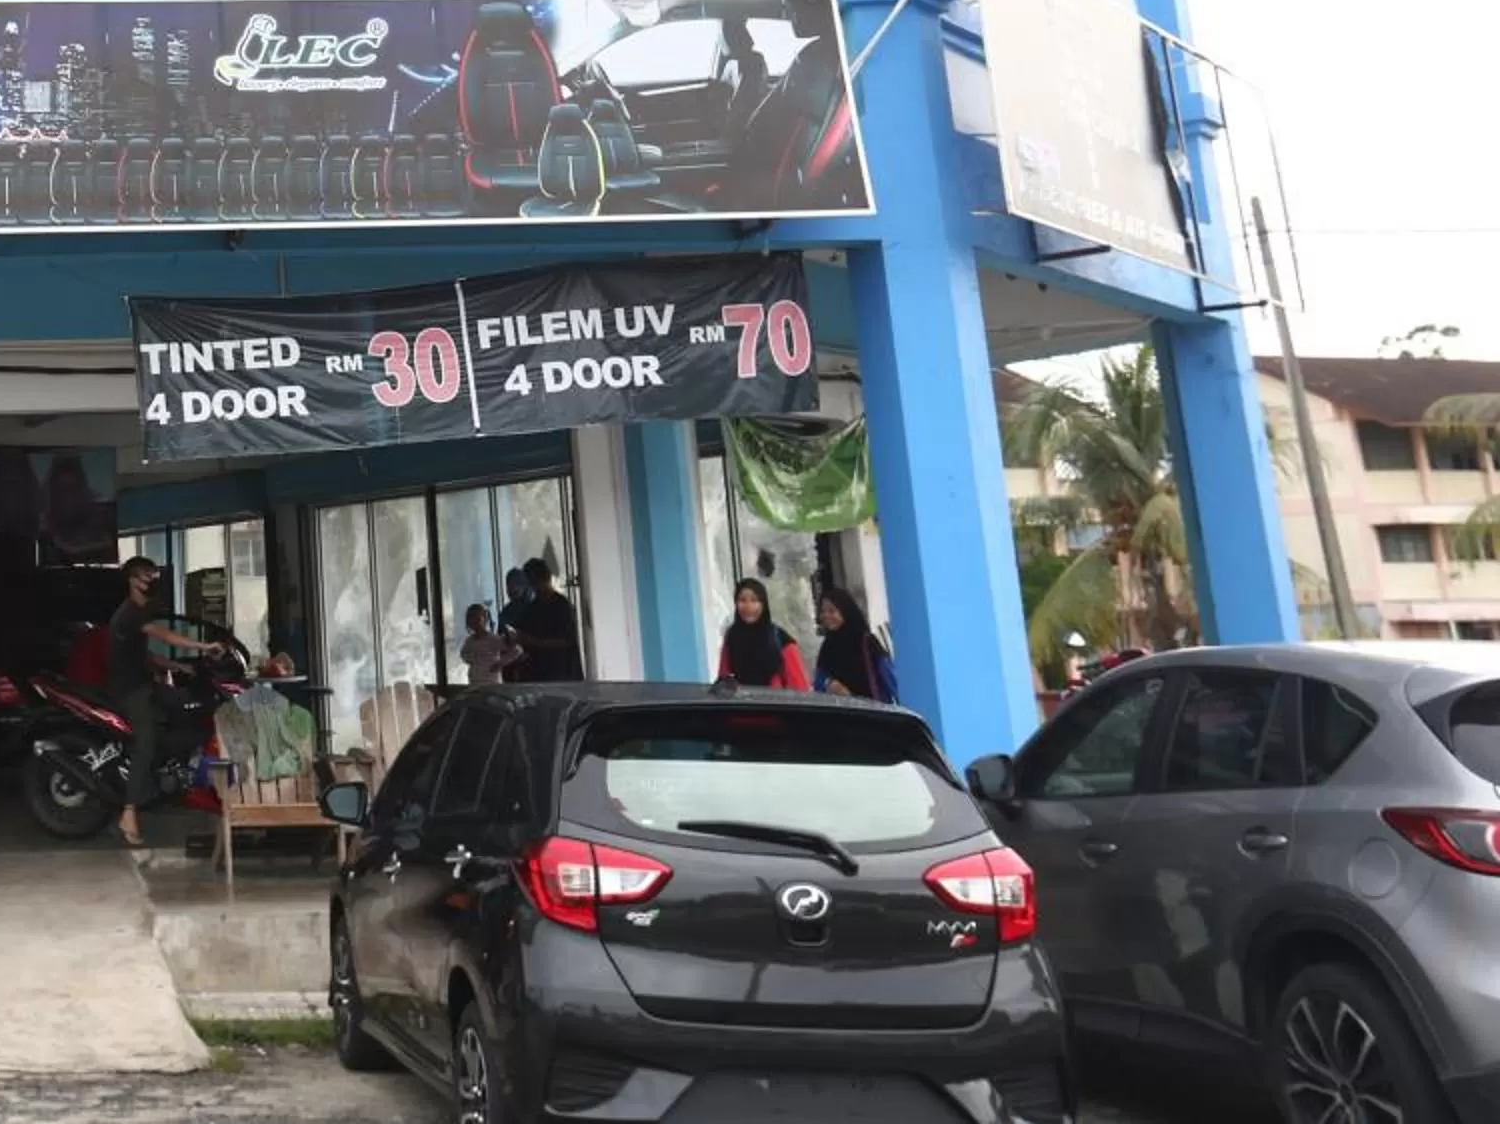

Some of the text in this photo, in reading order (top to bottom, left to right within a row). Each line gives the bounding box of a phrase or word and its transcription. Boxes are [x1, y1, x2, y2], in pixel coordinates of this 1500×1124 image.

[140, 327, 460, 407] TINTED RM 30
[477, 300, 812, 379] FILEM UV RM 70
[145, 385, 309, 425] 4 DOOR
[504, 355, 664, 396] 4 DOOR
